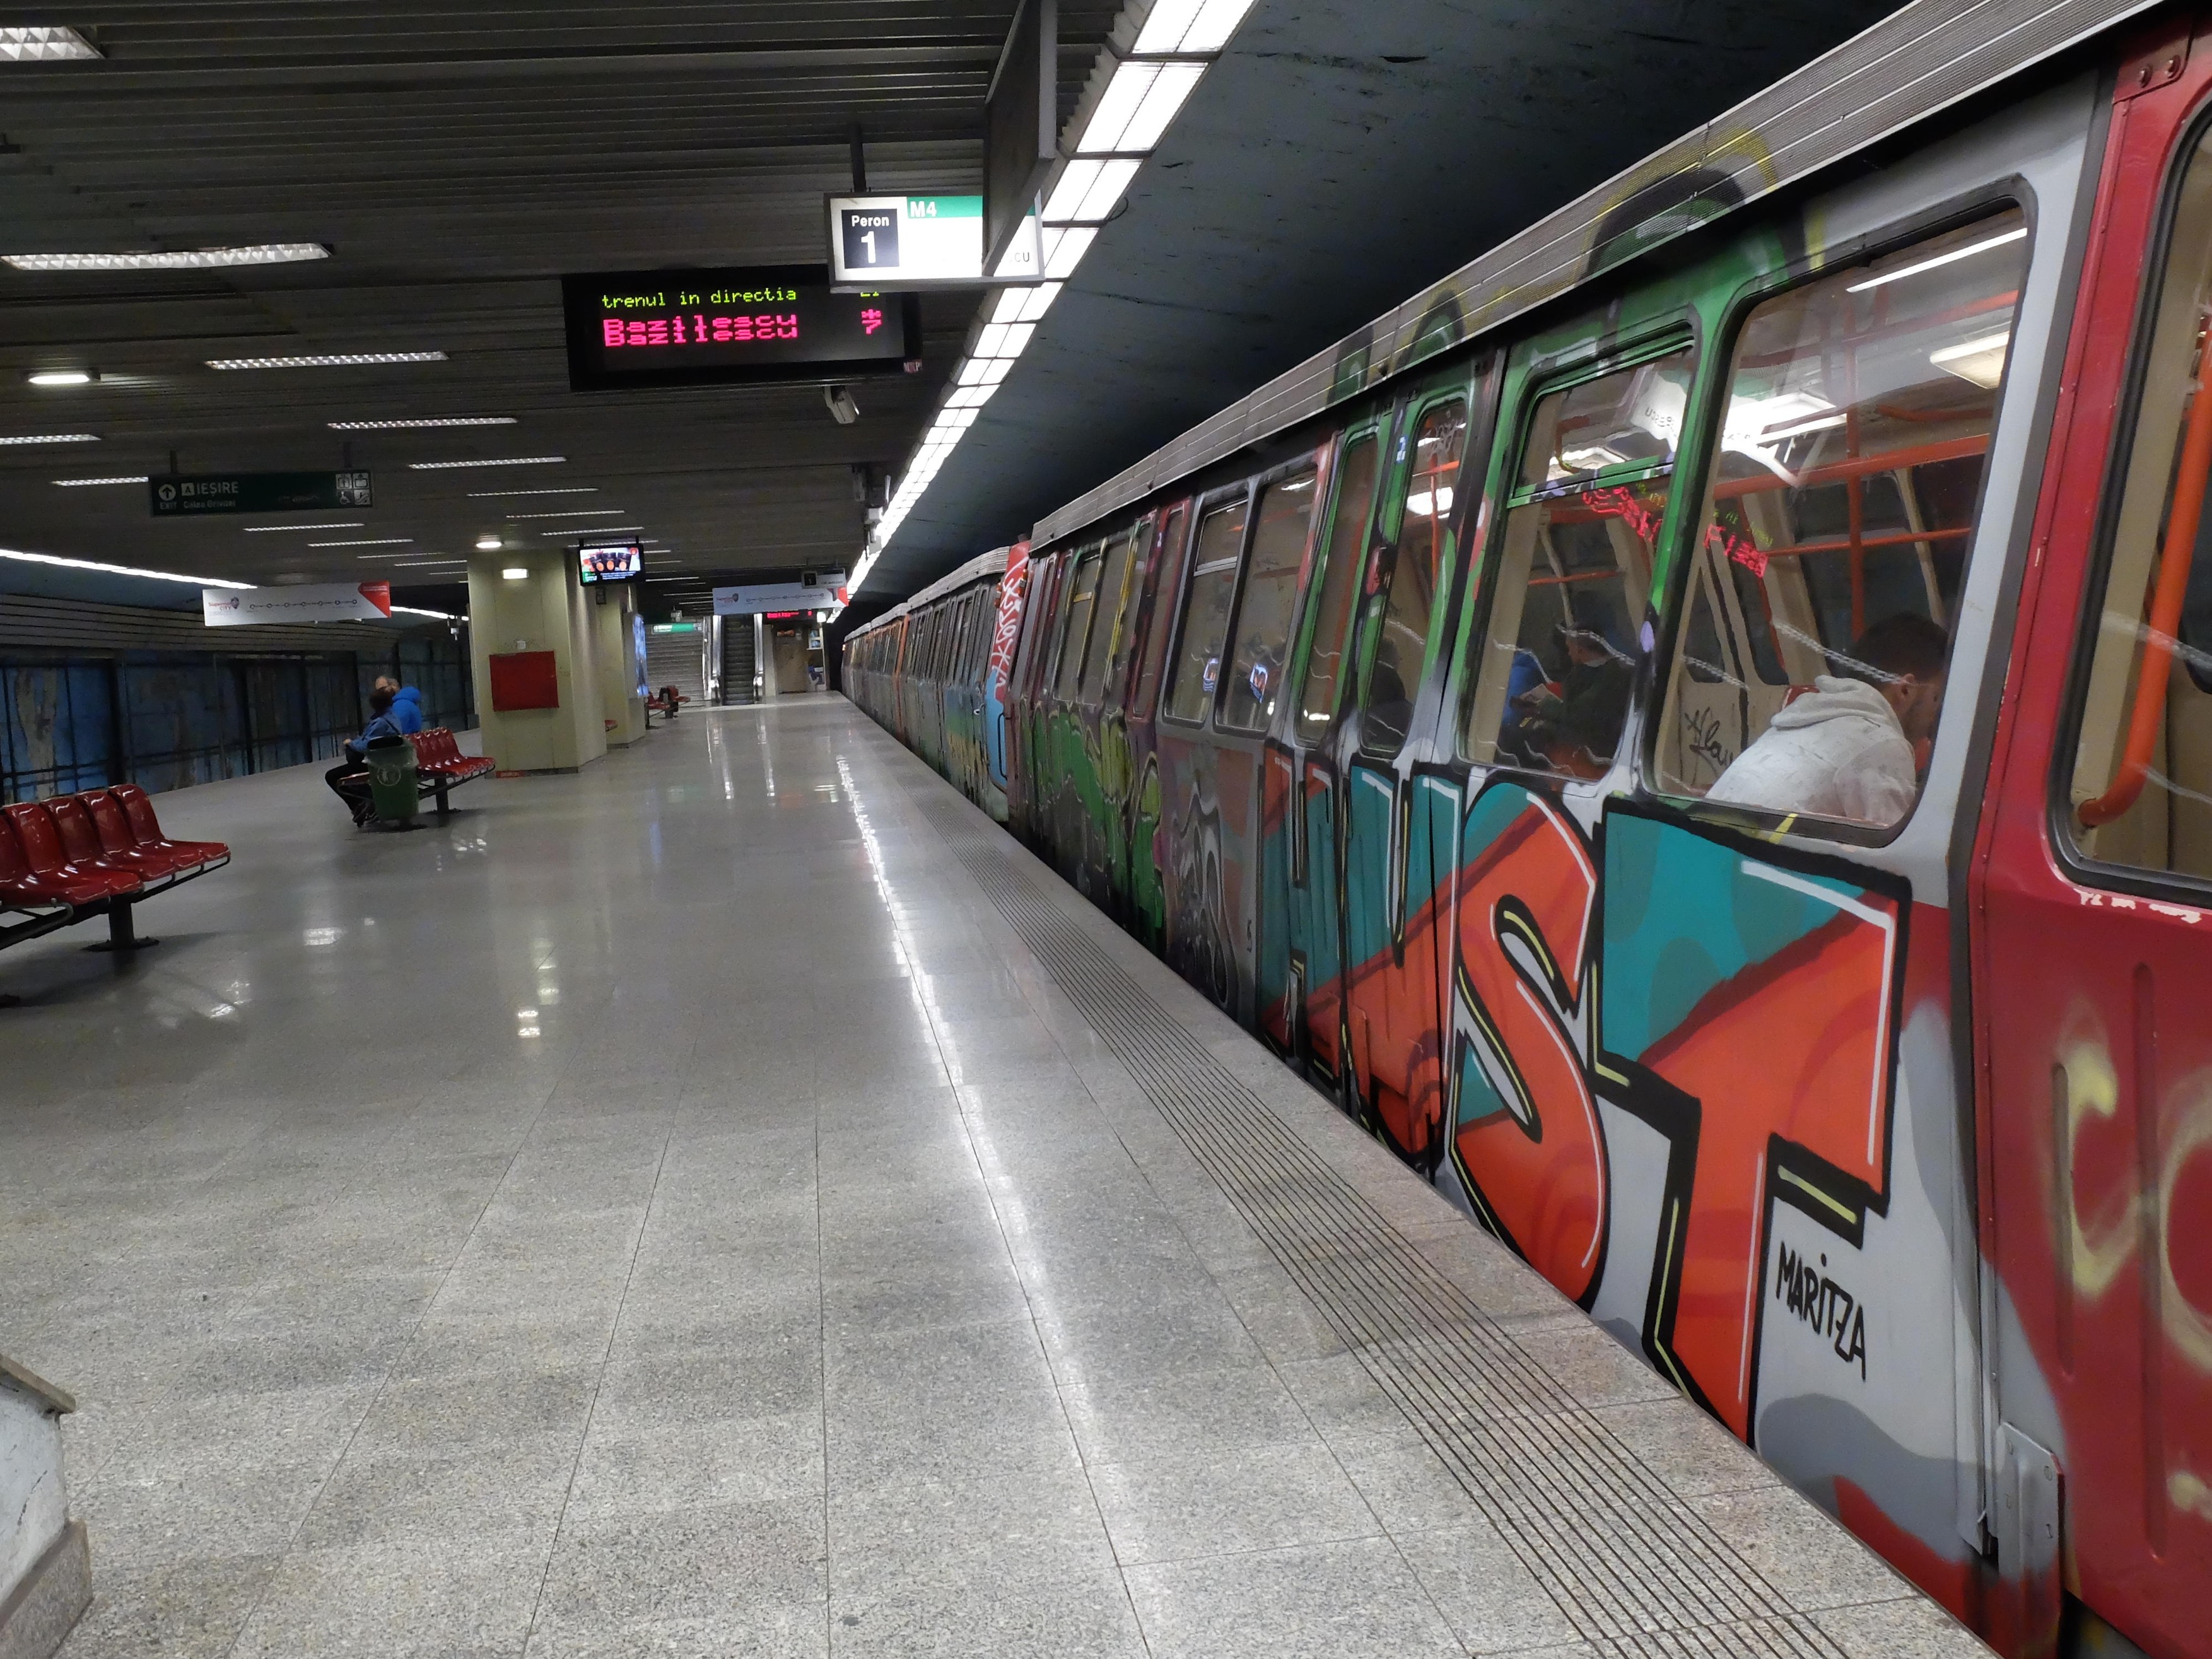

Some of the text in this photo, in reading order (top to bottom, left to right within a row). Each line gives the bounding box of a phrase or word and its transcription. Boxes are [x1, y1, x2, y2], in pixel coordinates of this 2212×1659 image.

[910, 201, 937, 218] M4
[851, 215, 890, 227] Peron
[860, 231, 877, 264] 1
[602, 287, 797, 308] trenul in directia
[603, 314, 799, 347] Bazilescu
